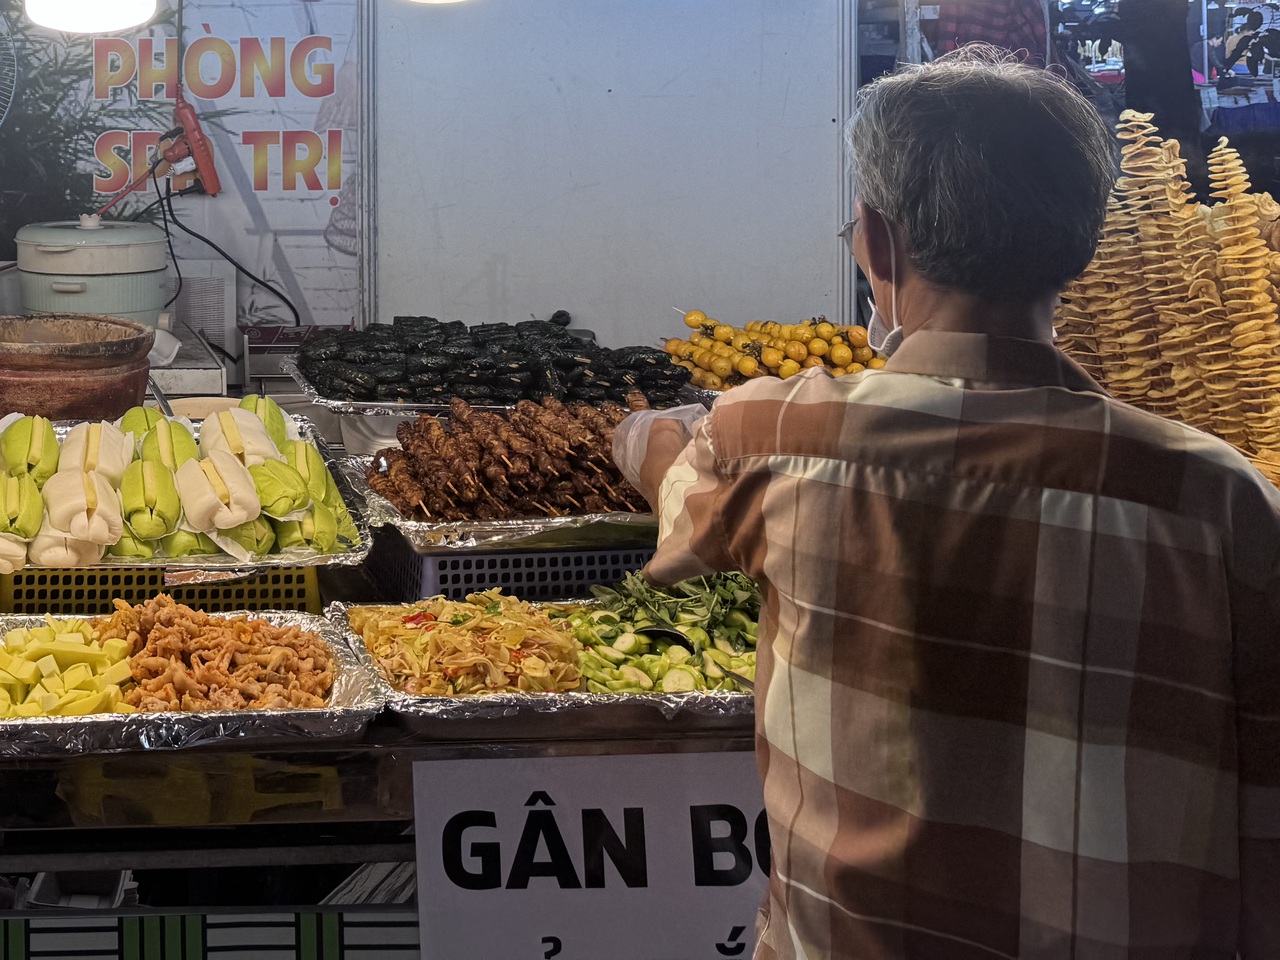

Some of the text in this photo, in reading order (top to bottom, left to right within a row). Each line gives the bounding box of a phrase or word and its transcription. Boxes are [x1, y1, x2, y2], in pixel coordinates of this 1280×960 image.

[92, 23, 336, 100] PHÒNG
[242, 129, 343, 208] TRỊ
[441, 791, 772, 890] GÂN B
